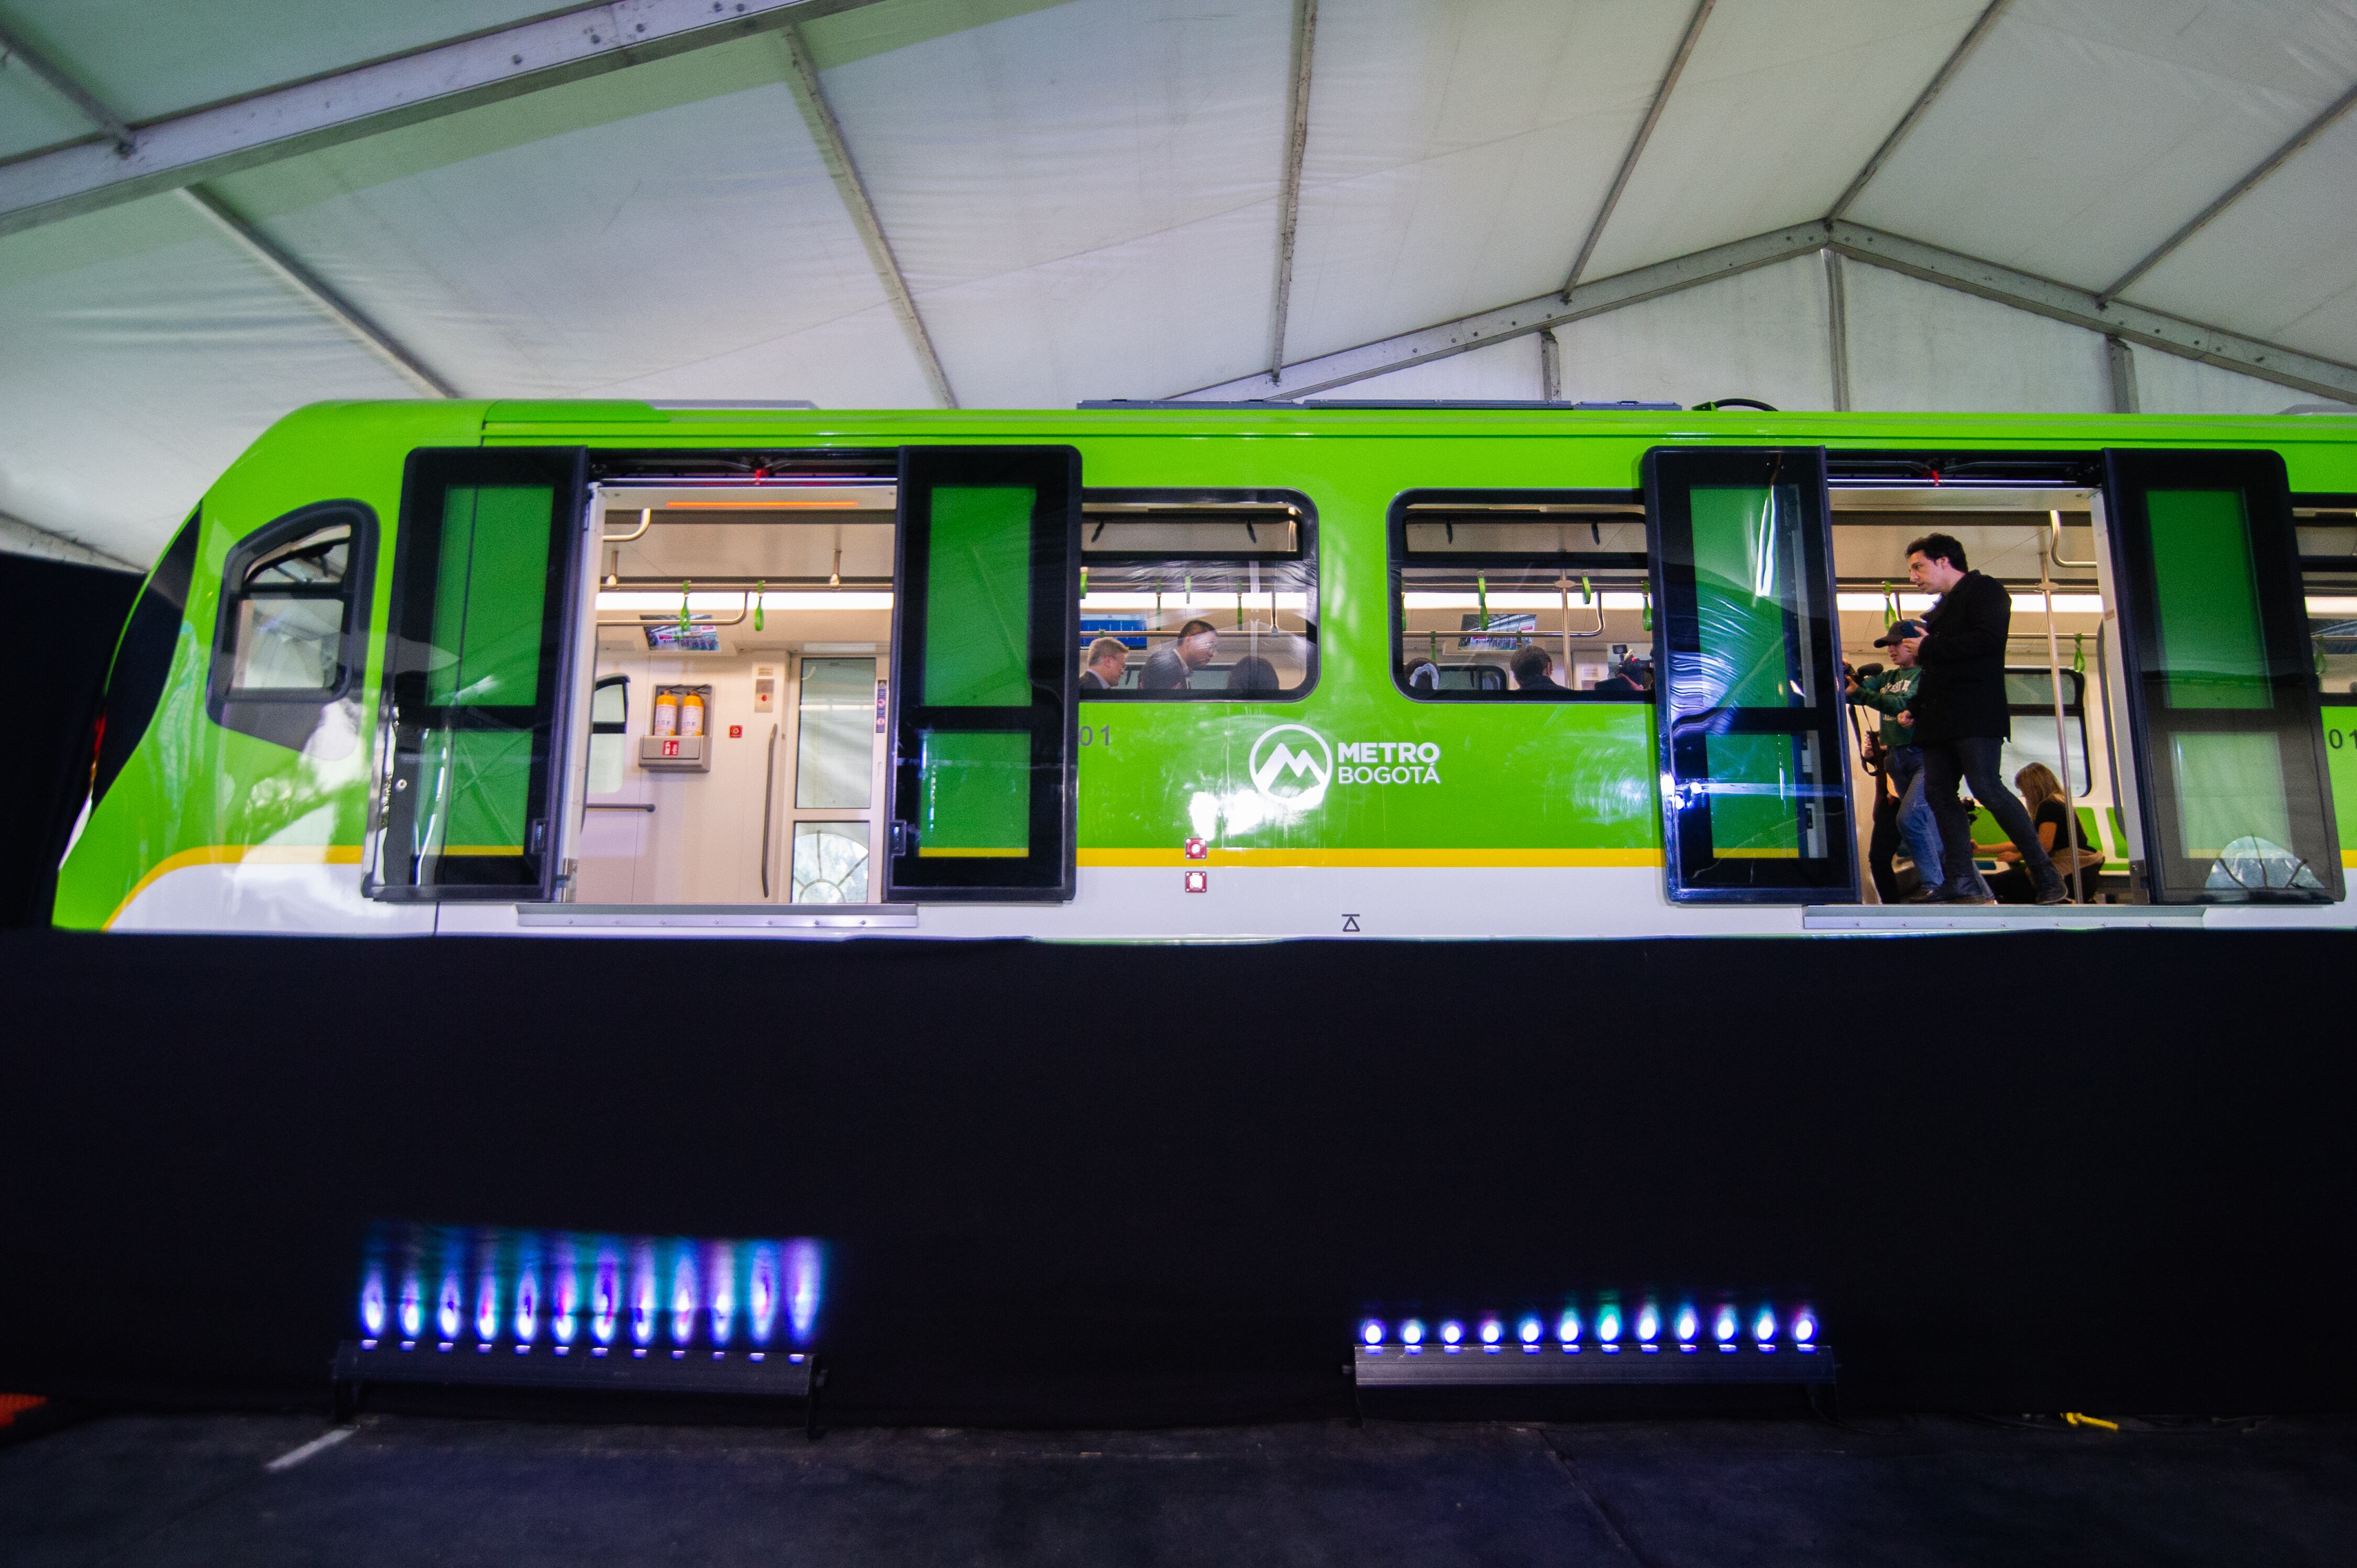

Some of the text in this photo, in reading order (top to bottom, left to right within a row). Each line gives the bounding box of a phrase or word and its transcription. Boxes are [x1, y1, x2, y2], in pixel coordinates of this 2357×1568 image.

[2329, 728, 2357, 749] 01
[1338, 742, 1440, 763] METRO
[1338, 763, 1440, 784] BOGOTÁ
